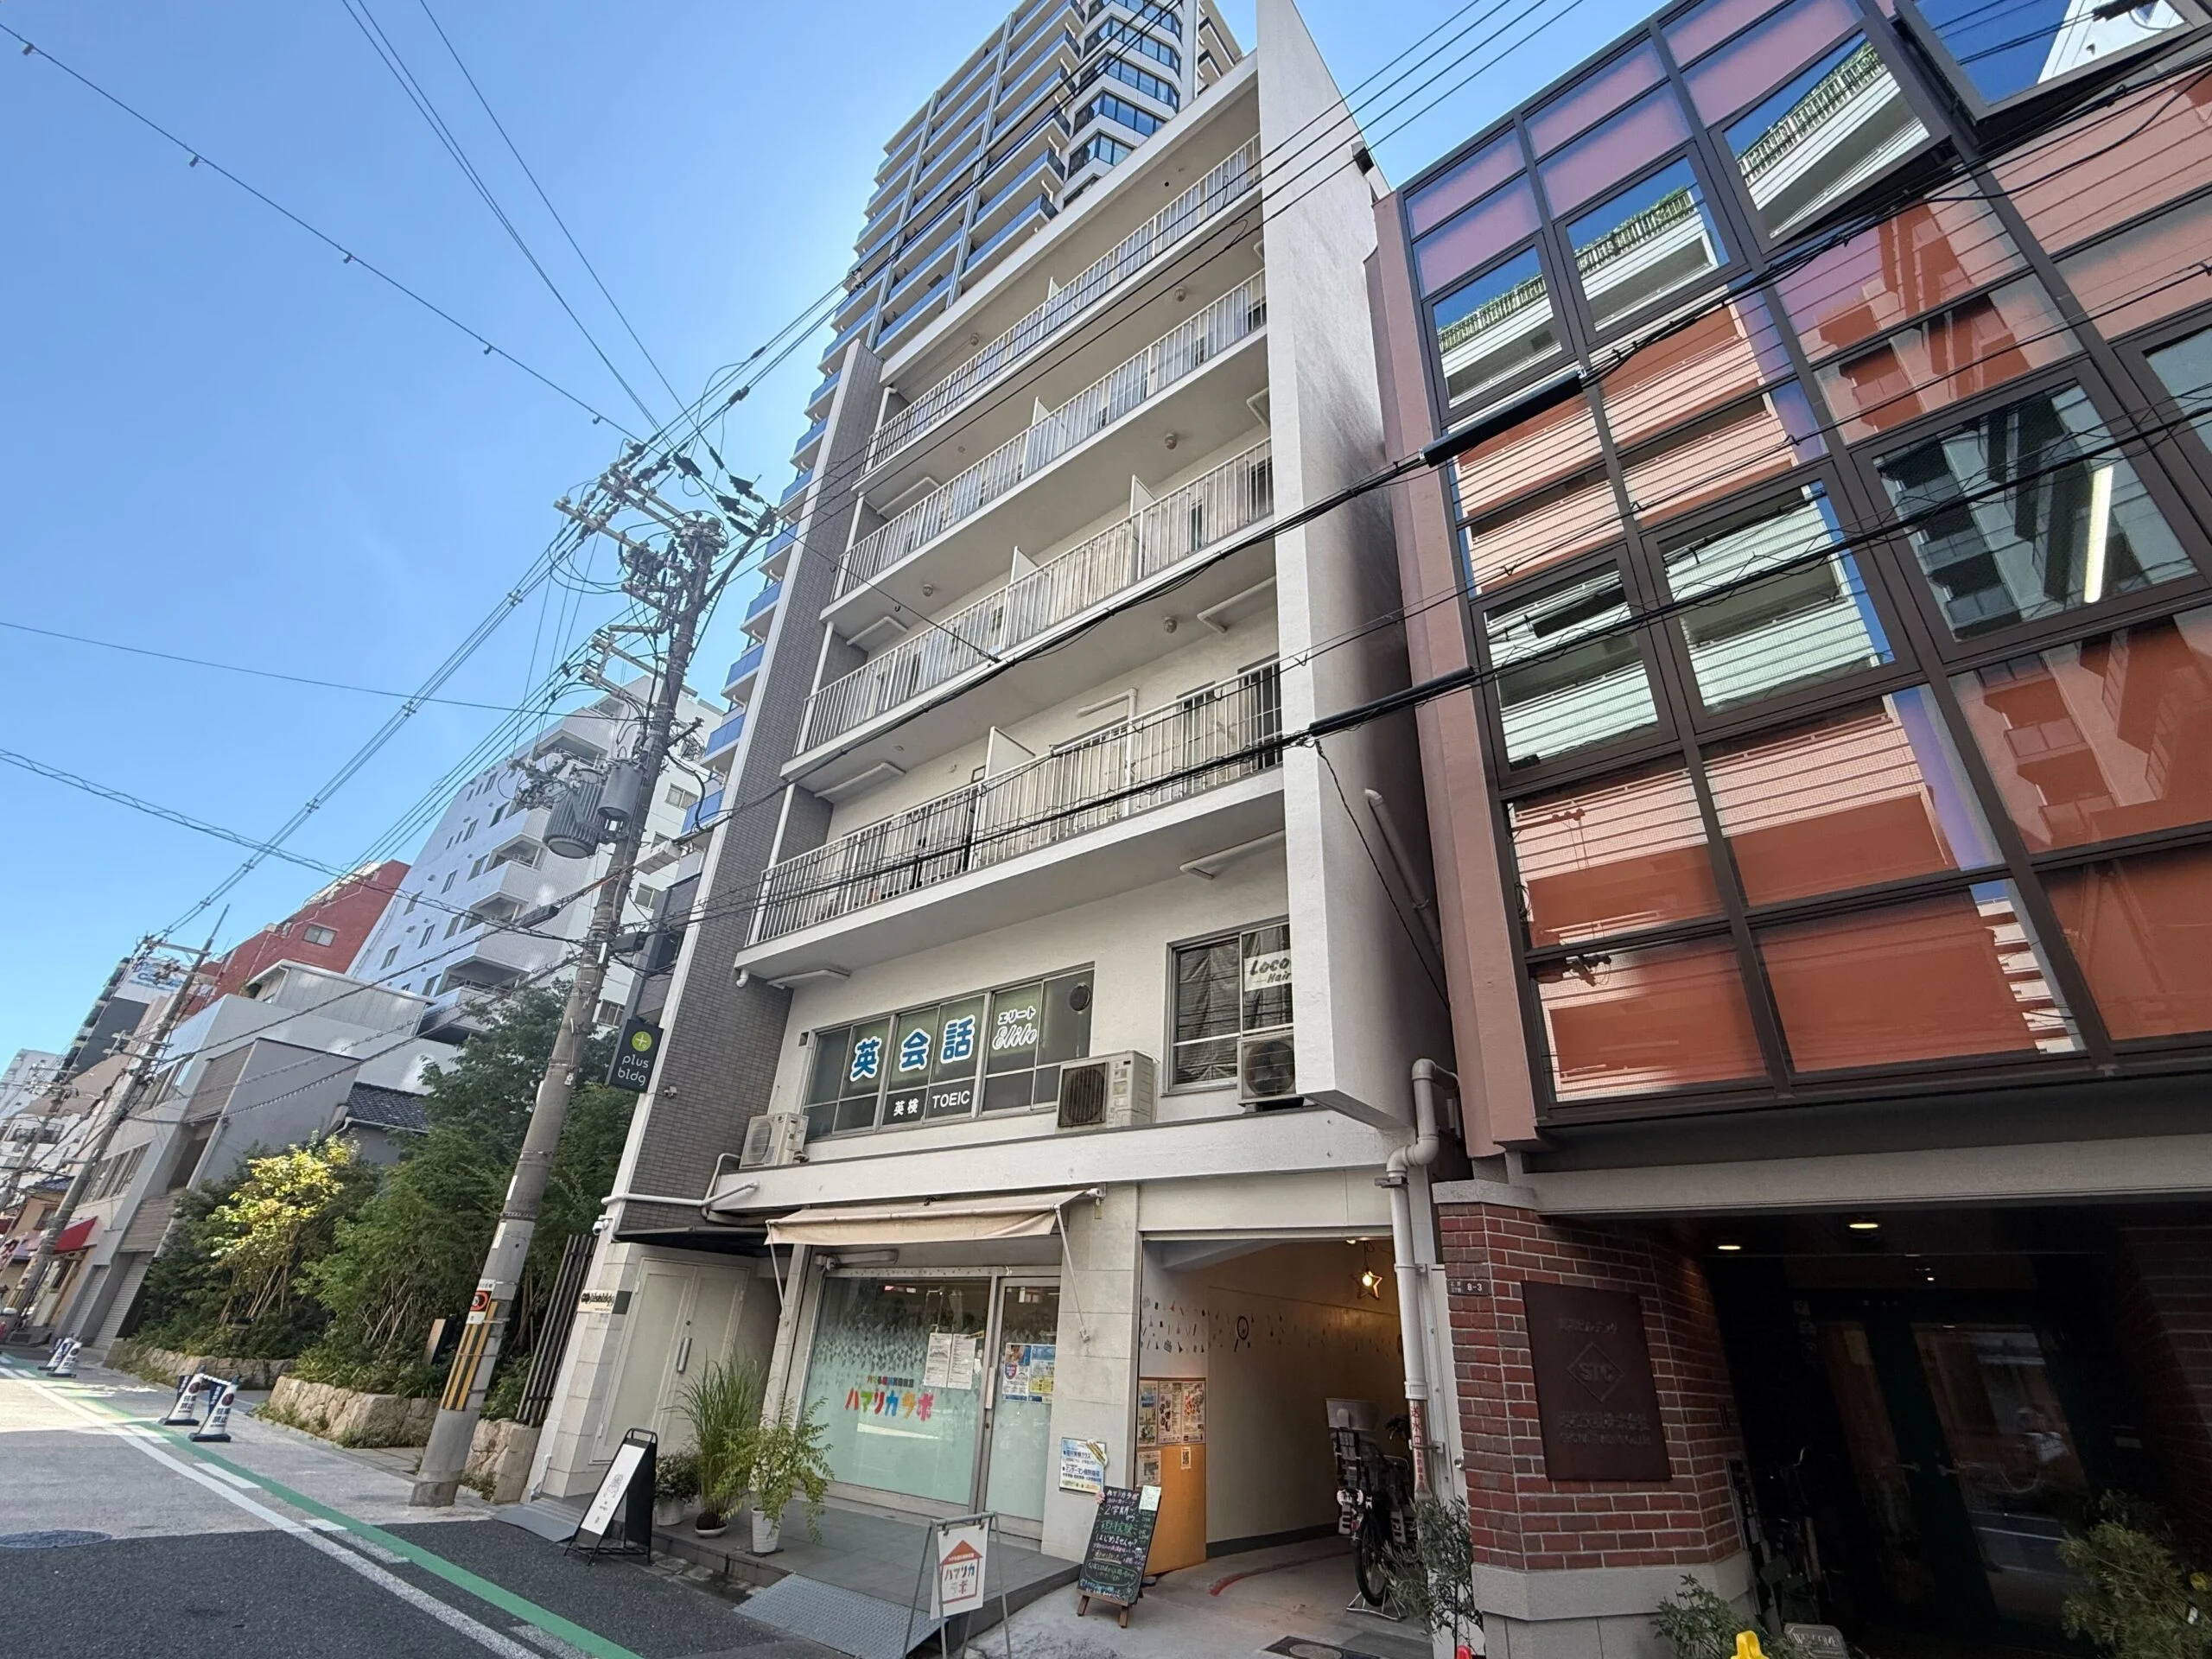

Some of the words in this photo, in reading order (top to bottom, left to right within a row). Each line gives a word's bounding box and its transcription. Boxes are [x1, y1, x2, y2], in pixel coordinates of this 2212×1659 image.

[1267, 970, 1292, 984] Hair
[997, 1005, 1037, 1026] エリート
[992, 1022, 1038, 1051] Elite
[849, 1014, 976, 1082] 英会話
[621, 1053, 650, 1069] plus
[616, 1066, 647, 1087] bldg
[893, 1097, 920, 1117] 英検
[931, 1090, 971, 1109] TOEIC
[844, 1386, 935, 1422] ハマリカラボ
[944, 1563, 976, 1582] ハマリカ
